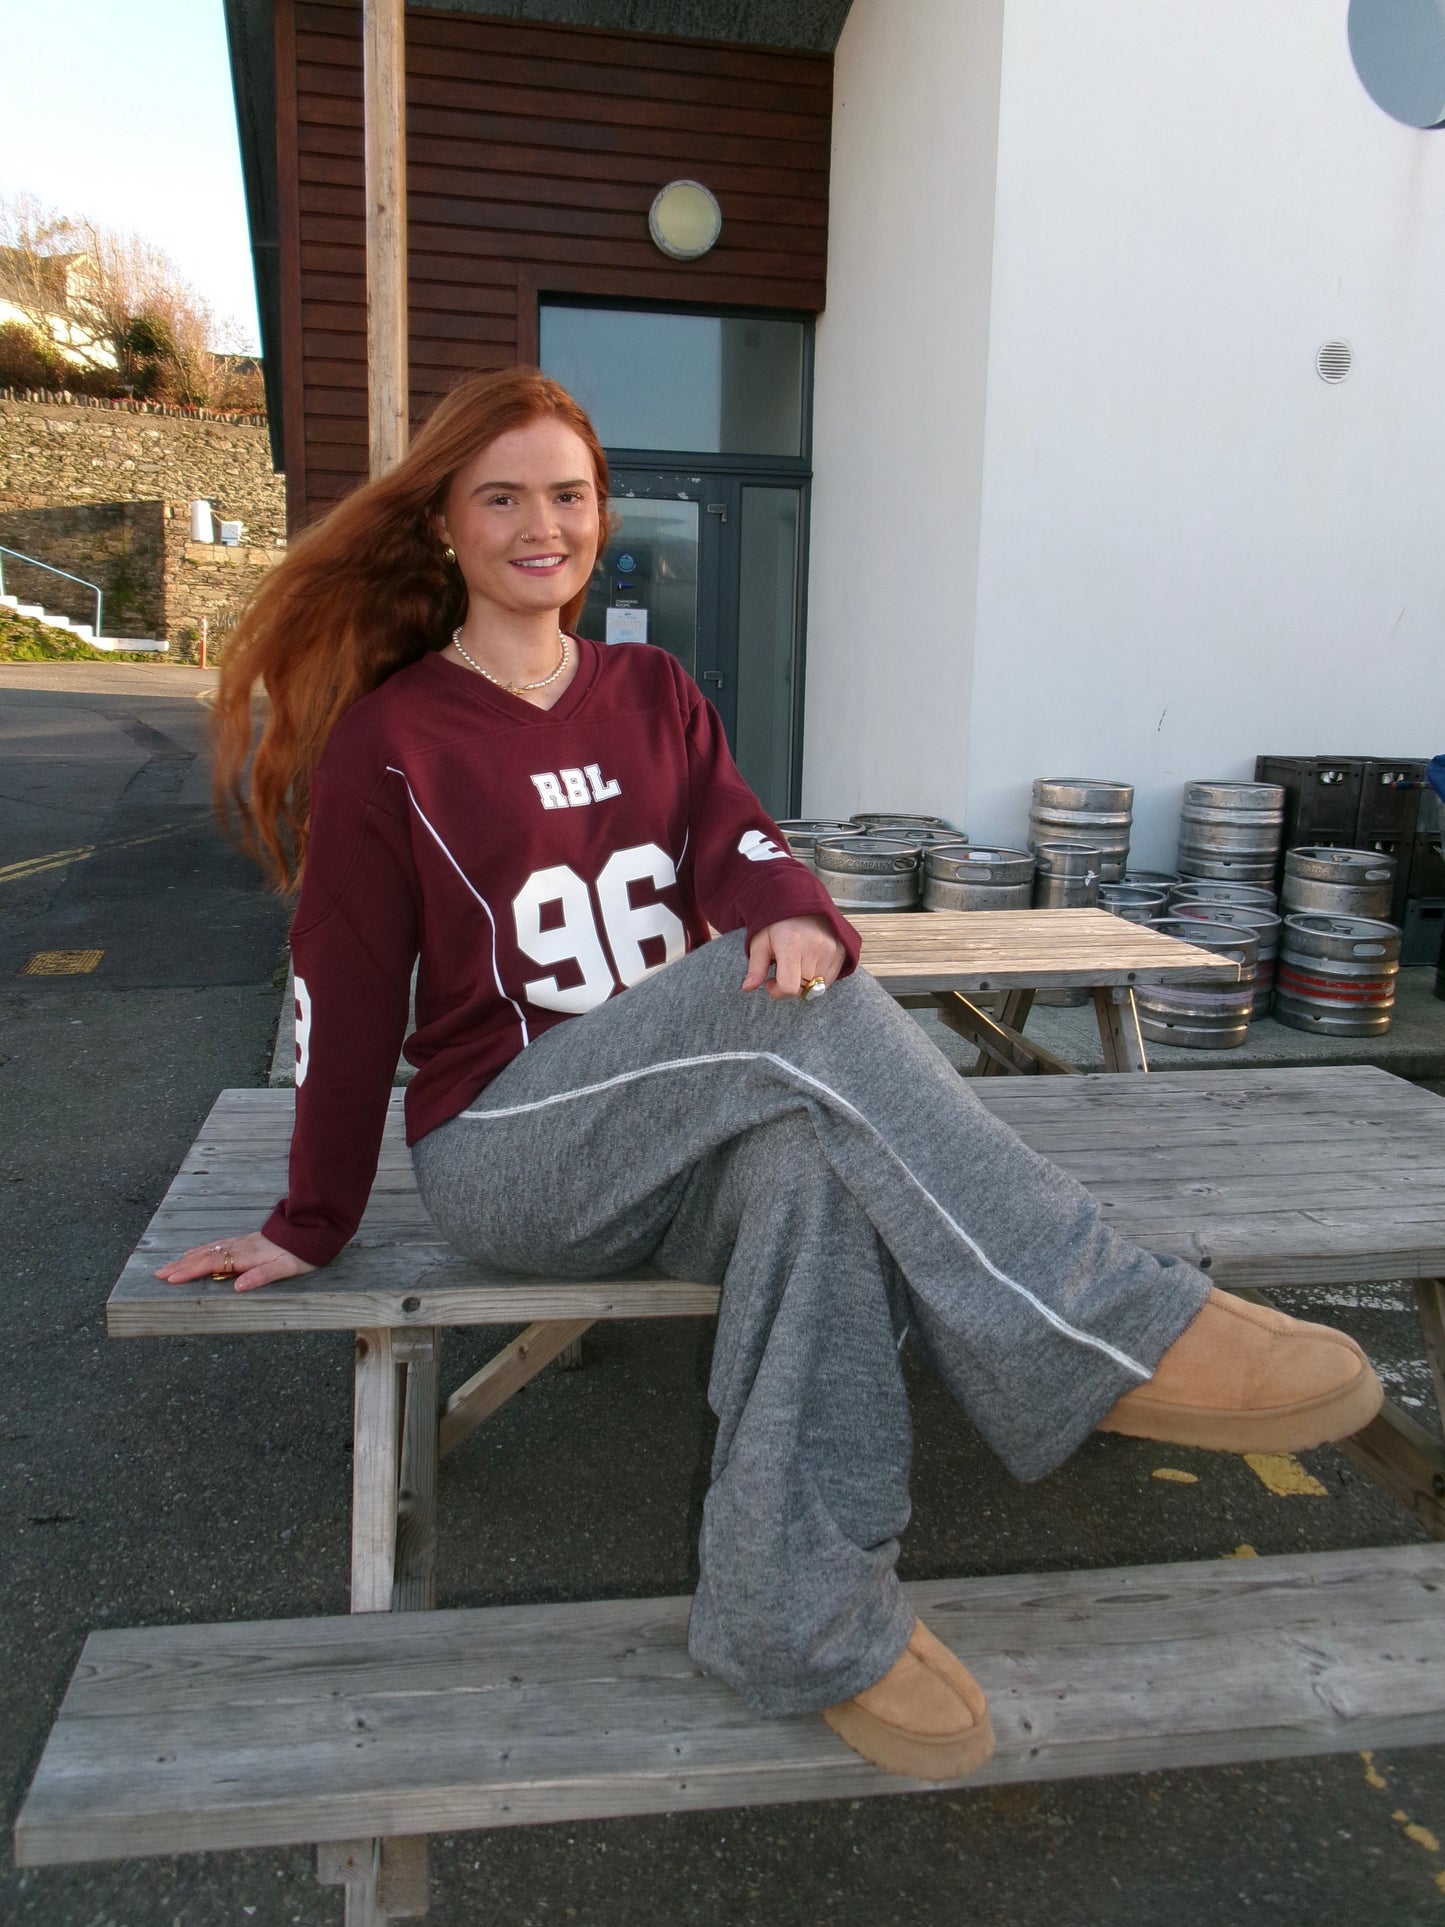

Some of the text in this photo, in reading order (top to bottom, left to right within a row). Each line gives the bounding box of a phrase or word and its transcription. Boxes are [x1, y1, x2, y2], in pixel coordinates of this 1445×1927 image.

[530, 764, 622, 810] RBL
[846, 858, 892, 869] COMPANY
[512, 842, 686, 1014] 96
